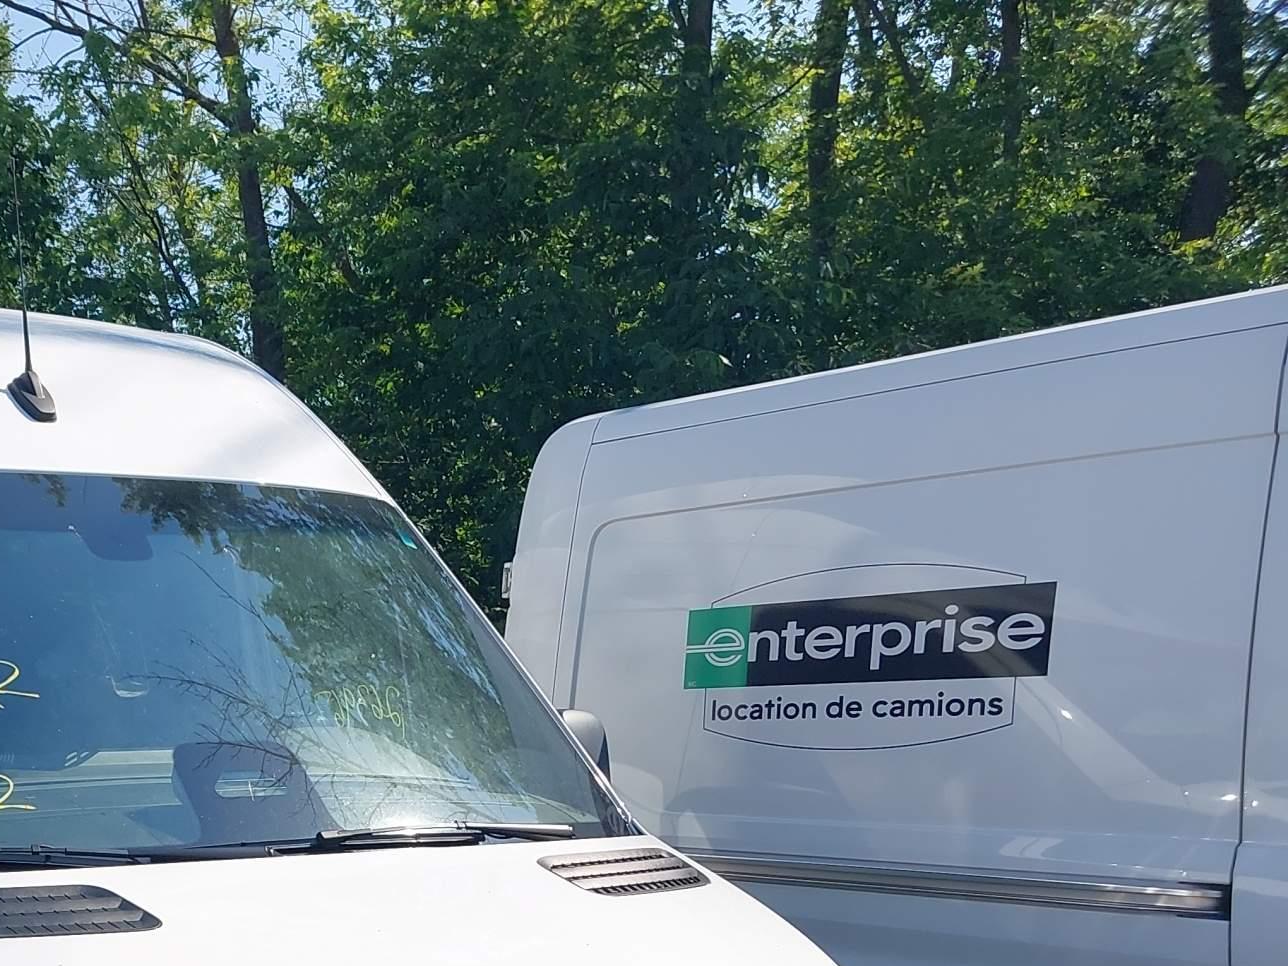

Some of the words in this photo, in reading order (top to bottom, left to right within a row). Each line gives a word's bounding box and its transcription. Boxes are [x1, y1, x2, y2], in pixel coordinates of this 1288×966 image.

[686, 604, 1046, 671] enterprise
[711, 696, 817, 722] location
[825, 696, 862, 720] de
[872, 691, 1004, 719] camions
